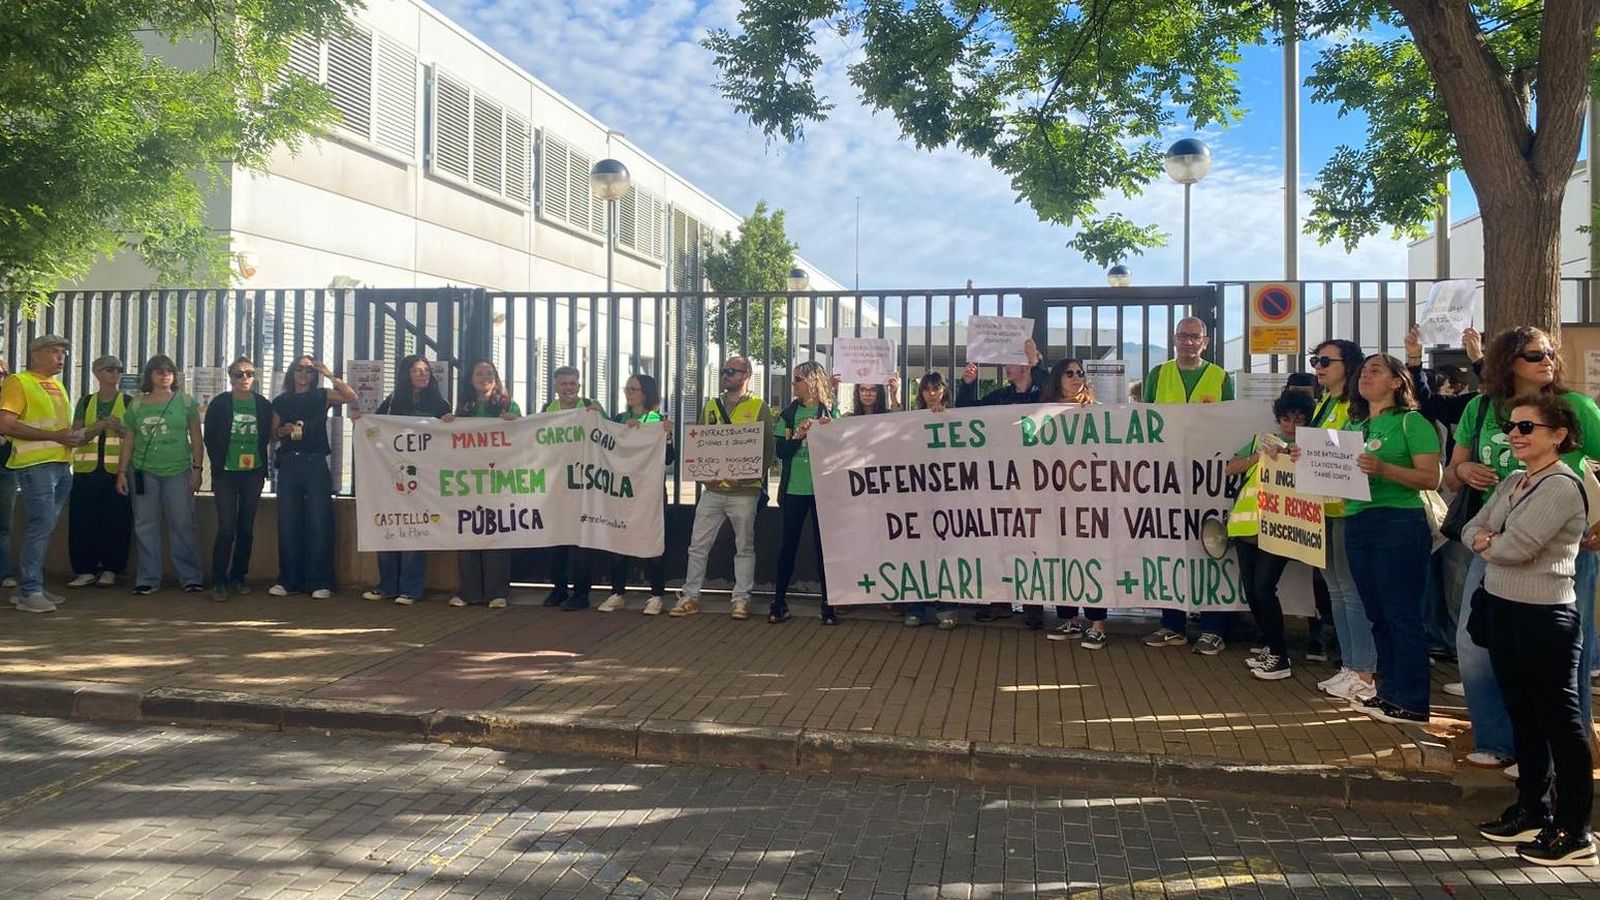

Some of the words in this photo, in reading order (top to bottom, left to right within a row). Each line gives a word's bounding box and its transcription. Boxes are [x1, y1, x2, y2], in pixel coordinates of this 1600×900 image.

[393, 433, 432, 452] CEIP
[452, 431, 512, 449] MANEL
[924, 419, 986, 449] IES
[1021, 408, 1165, 447] BOVALAR
[439, 462, 547, 497] ESTIMEM
[849, 459, 978, 497] DEFENSEM
[989, 459, 1021, 491] LA
[1033, 452, 1181, 494] DOCÈNCIA
[1192, 452, 1240, 499] PÚB
[1260, 467, 1270, 483] LA
[1275, 470, 1296, 488] INCL
[374, 509, 430, 527] CASTELLÓ
[458, 503, 544, 535] PÚBLICA
[886, 512, 921, 541] DE
[933, 506, 1041, 542] QUALITAT
[1060, 507, 1067, 537] I
[1075, 507, 1109, 538] EN
[1257, 490, 1280, 514] SENSE
[1284, 496, 1322, 524] RECURSOS
[1261, 516, 1268, 535] ÉS
[1269, 522, 1322, 549] DISCRIMINACIÓ
[1116, 557, 1246, 606] +RECURS
